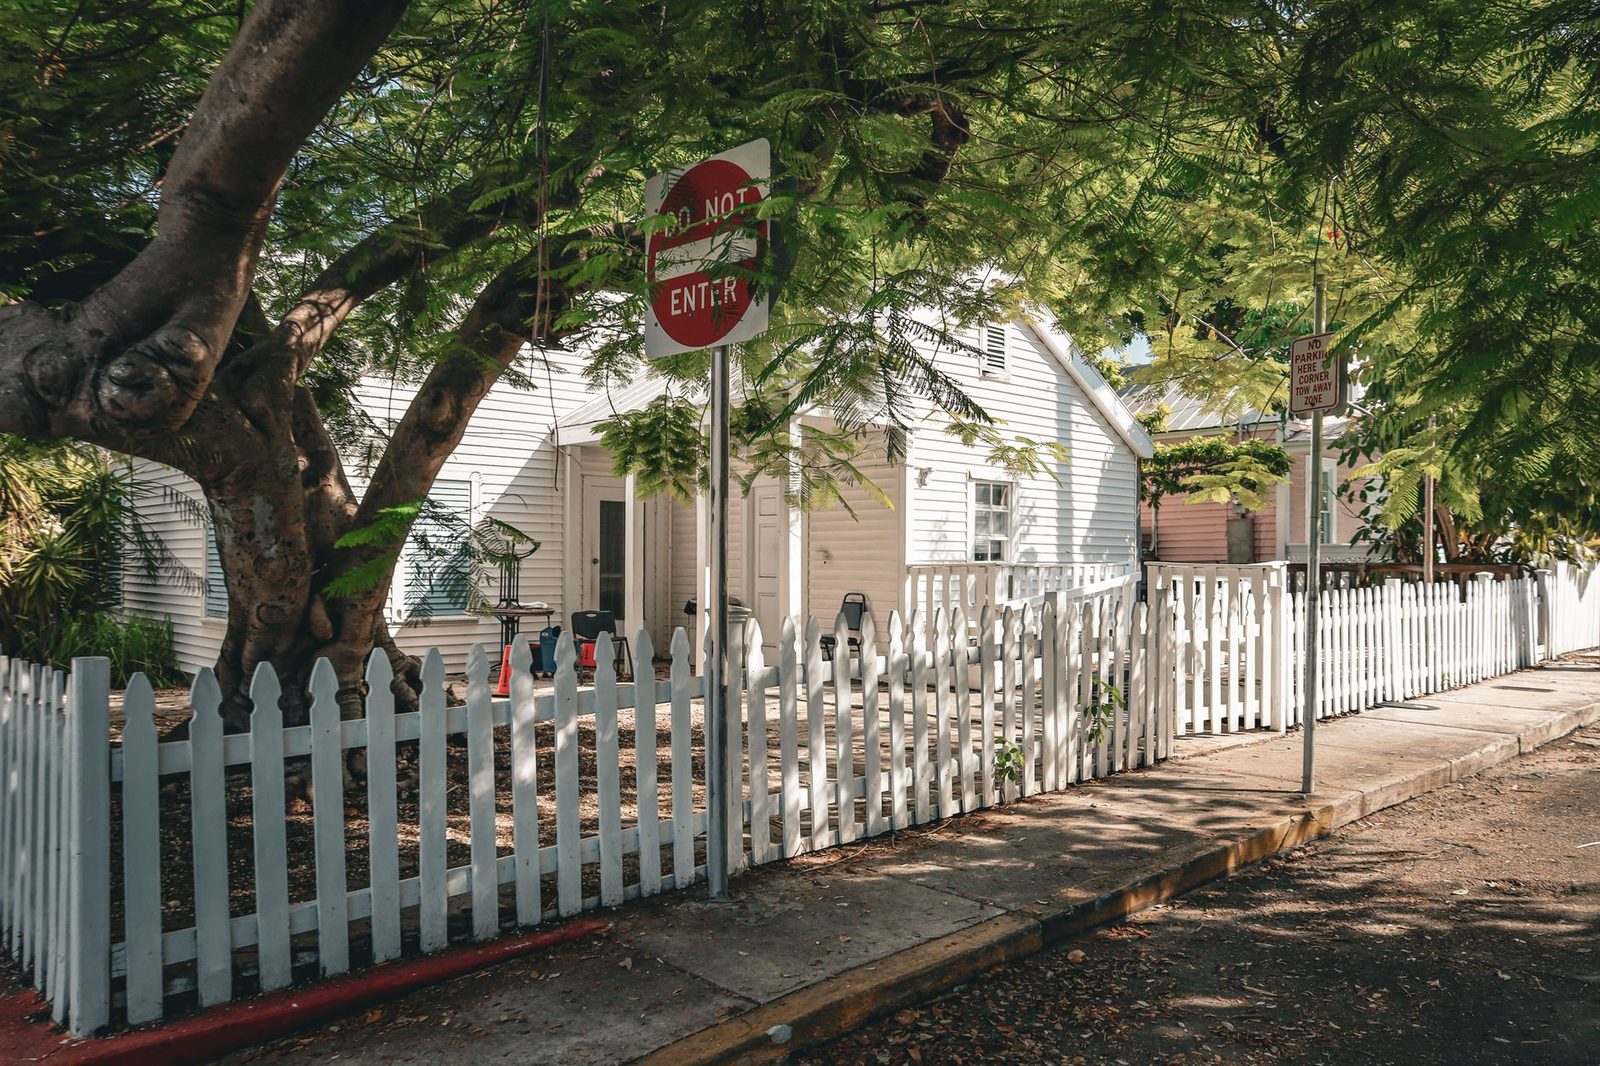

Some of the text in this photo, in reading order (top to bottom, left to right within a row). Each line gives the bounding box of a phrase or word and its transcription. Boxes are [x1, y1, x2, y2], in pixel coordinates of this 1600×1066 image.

[705, 188, 748, 226] NOT
[671, 276, 737, 315] ENTER
[1308, 339, 1321, 351] NO
[1297, 362, 1317, 374] HERE
[1298, 371, 1329, 385] CORNER
[1296, 381, 1332, 396] TOW AWAY
[1304, 394, 1323, 406] ZONE
